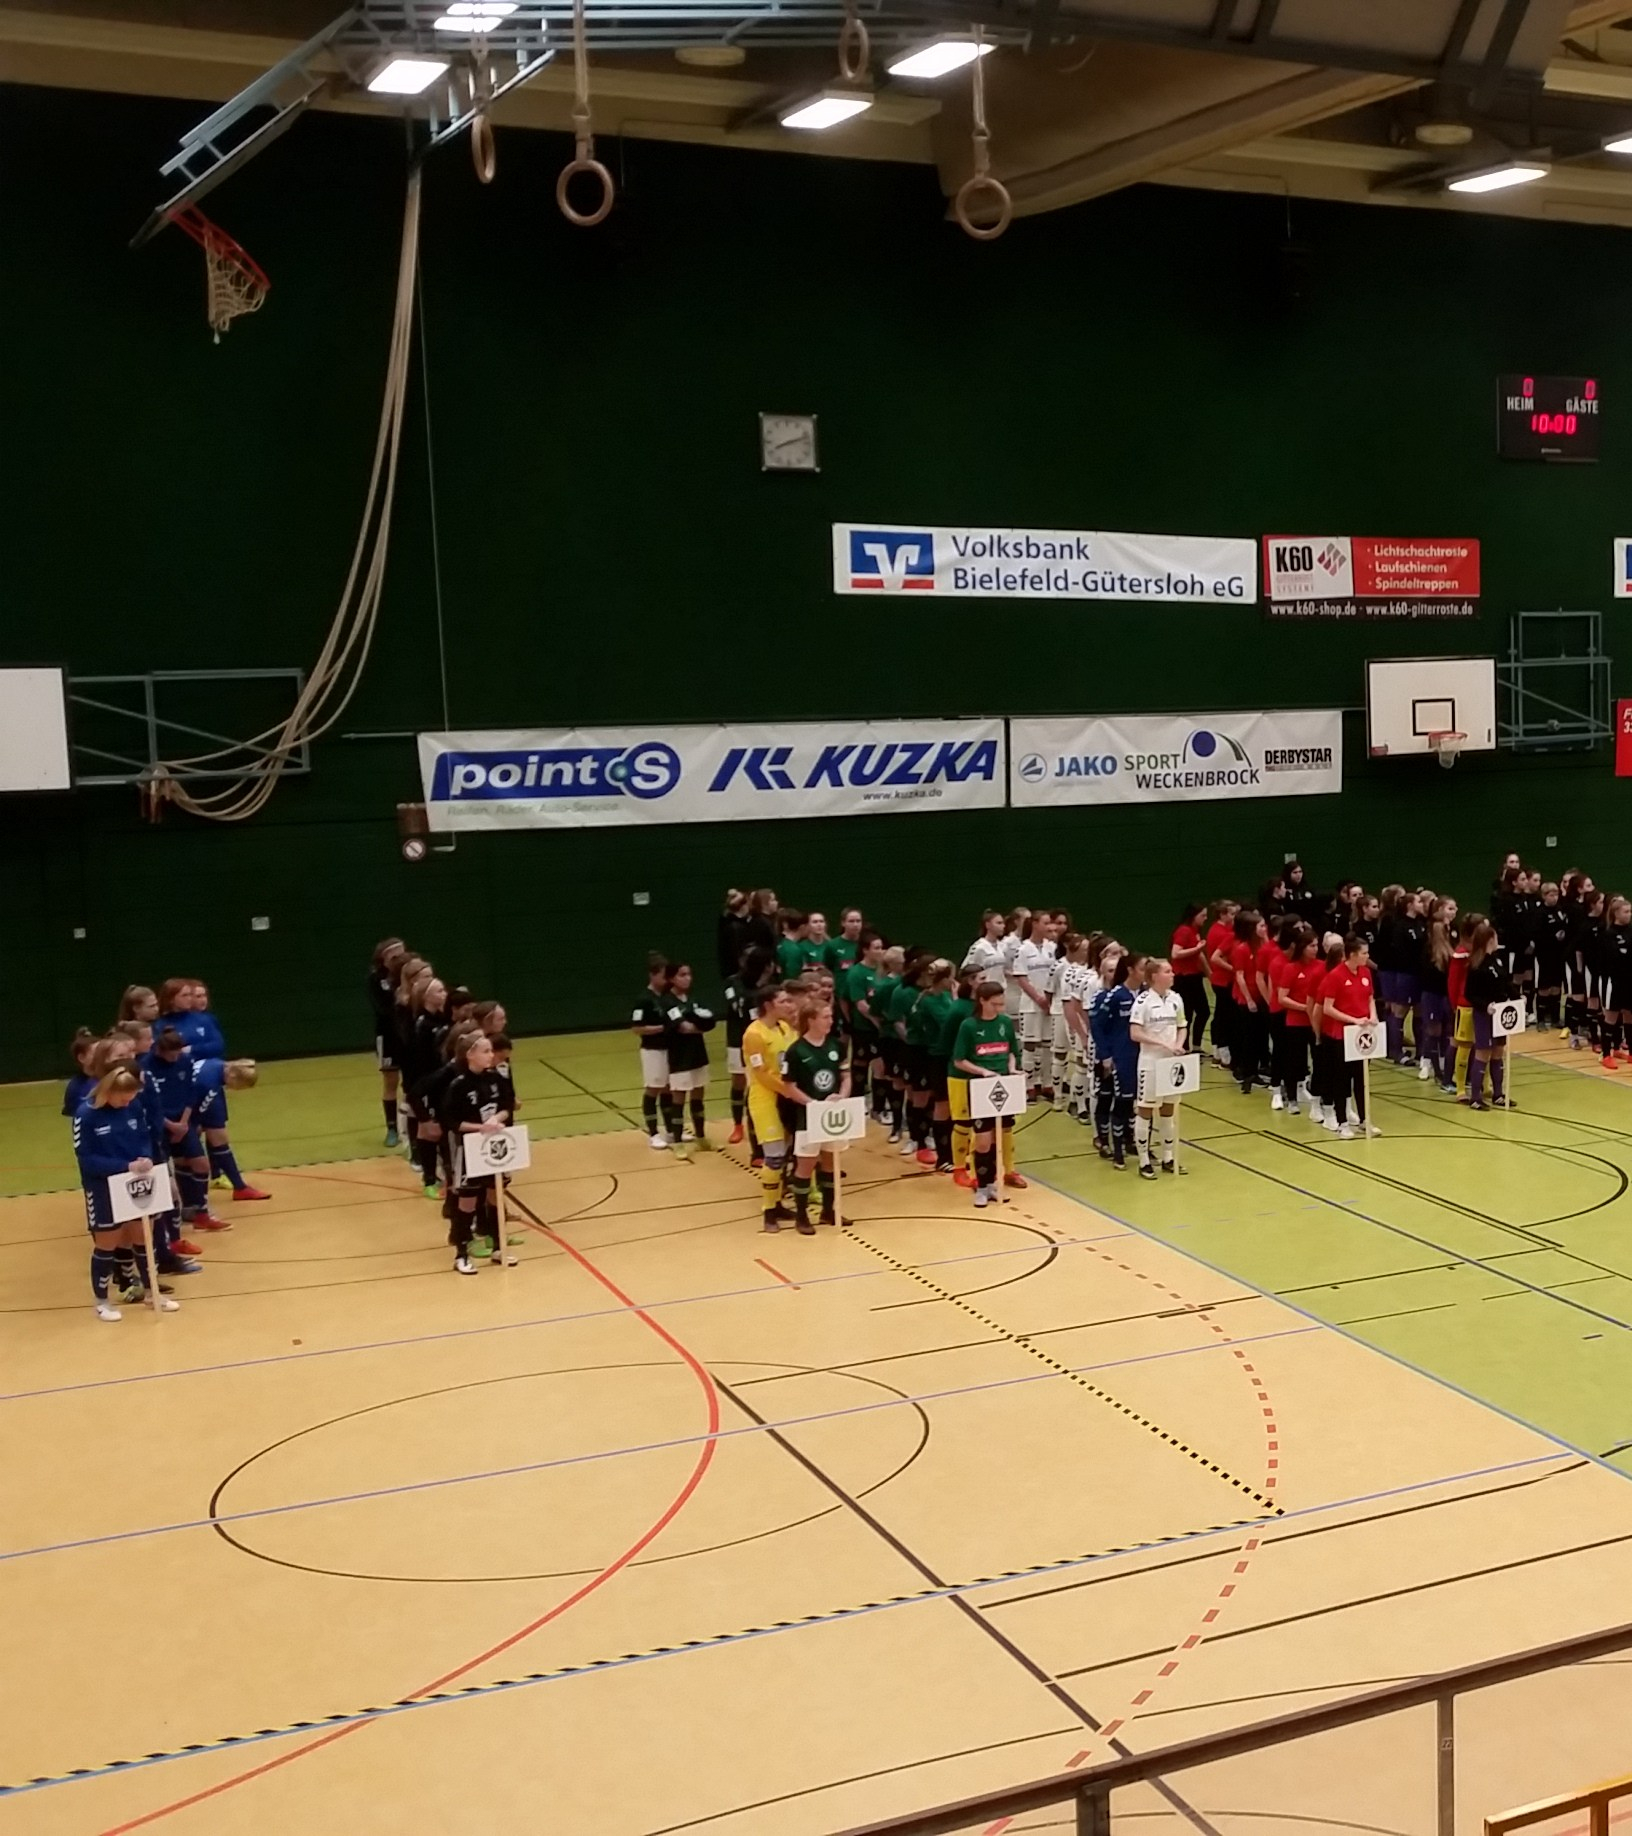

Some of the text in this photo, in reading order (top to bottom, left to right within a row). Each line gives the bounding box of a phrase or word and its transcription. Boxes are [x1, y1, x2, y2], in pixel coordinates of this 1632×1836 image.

[1507, 396, 1599, 414] HEIM GÄSTE
[952, 534, 1090, 561] Volksbank
[1275, 545, 1313, 573] K60
[1375, 562, 1448, 573] Laufschienen
[953, 568, 1244, 597] Bielefeld-Gütersloh eG
[1375, 577, 1459, 591] Spindeltreppen
[1271, 601, 1473, 618] www.k60-shop.de www.k60-gitterroste.de
[803, 740, 998, 788] KUZKA
[1055, 754, 1180, 777] JAKO SPORT
[1264, 748, 1332, 765] DERBYSTAR
[450, 750, 671, 796] point S
[1136, 768, 1260, 789] WECKENBROCK
[863, 788, 943, 801] www.kuzka.de
[129, 1180, 152, 1194] USV
